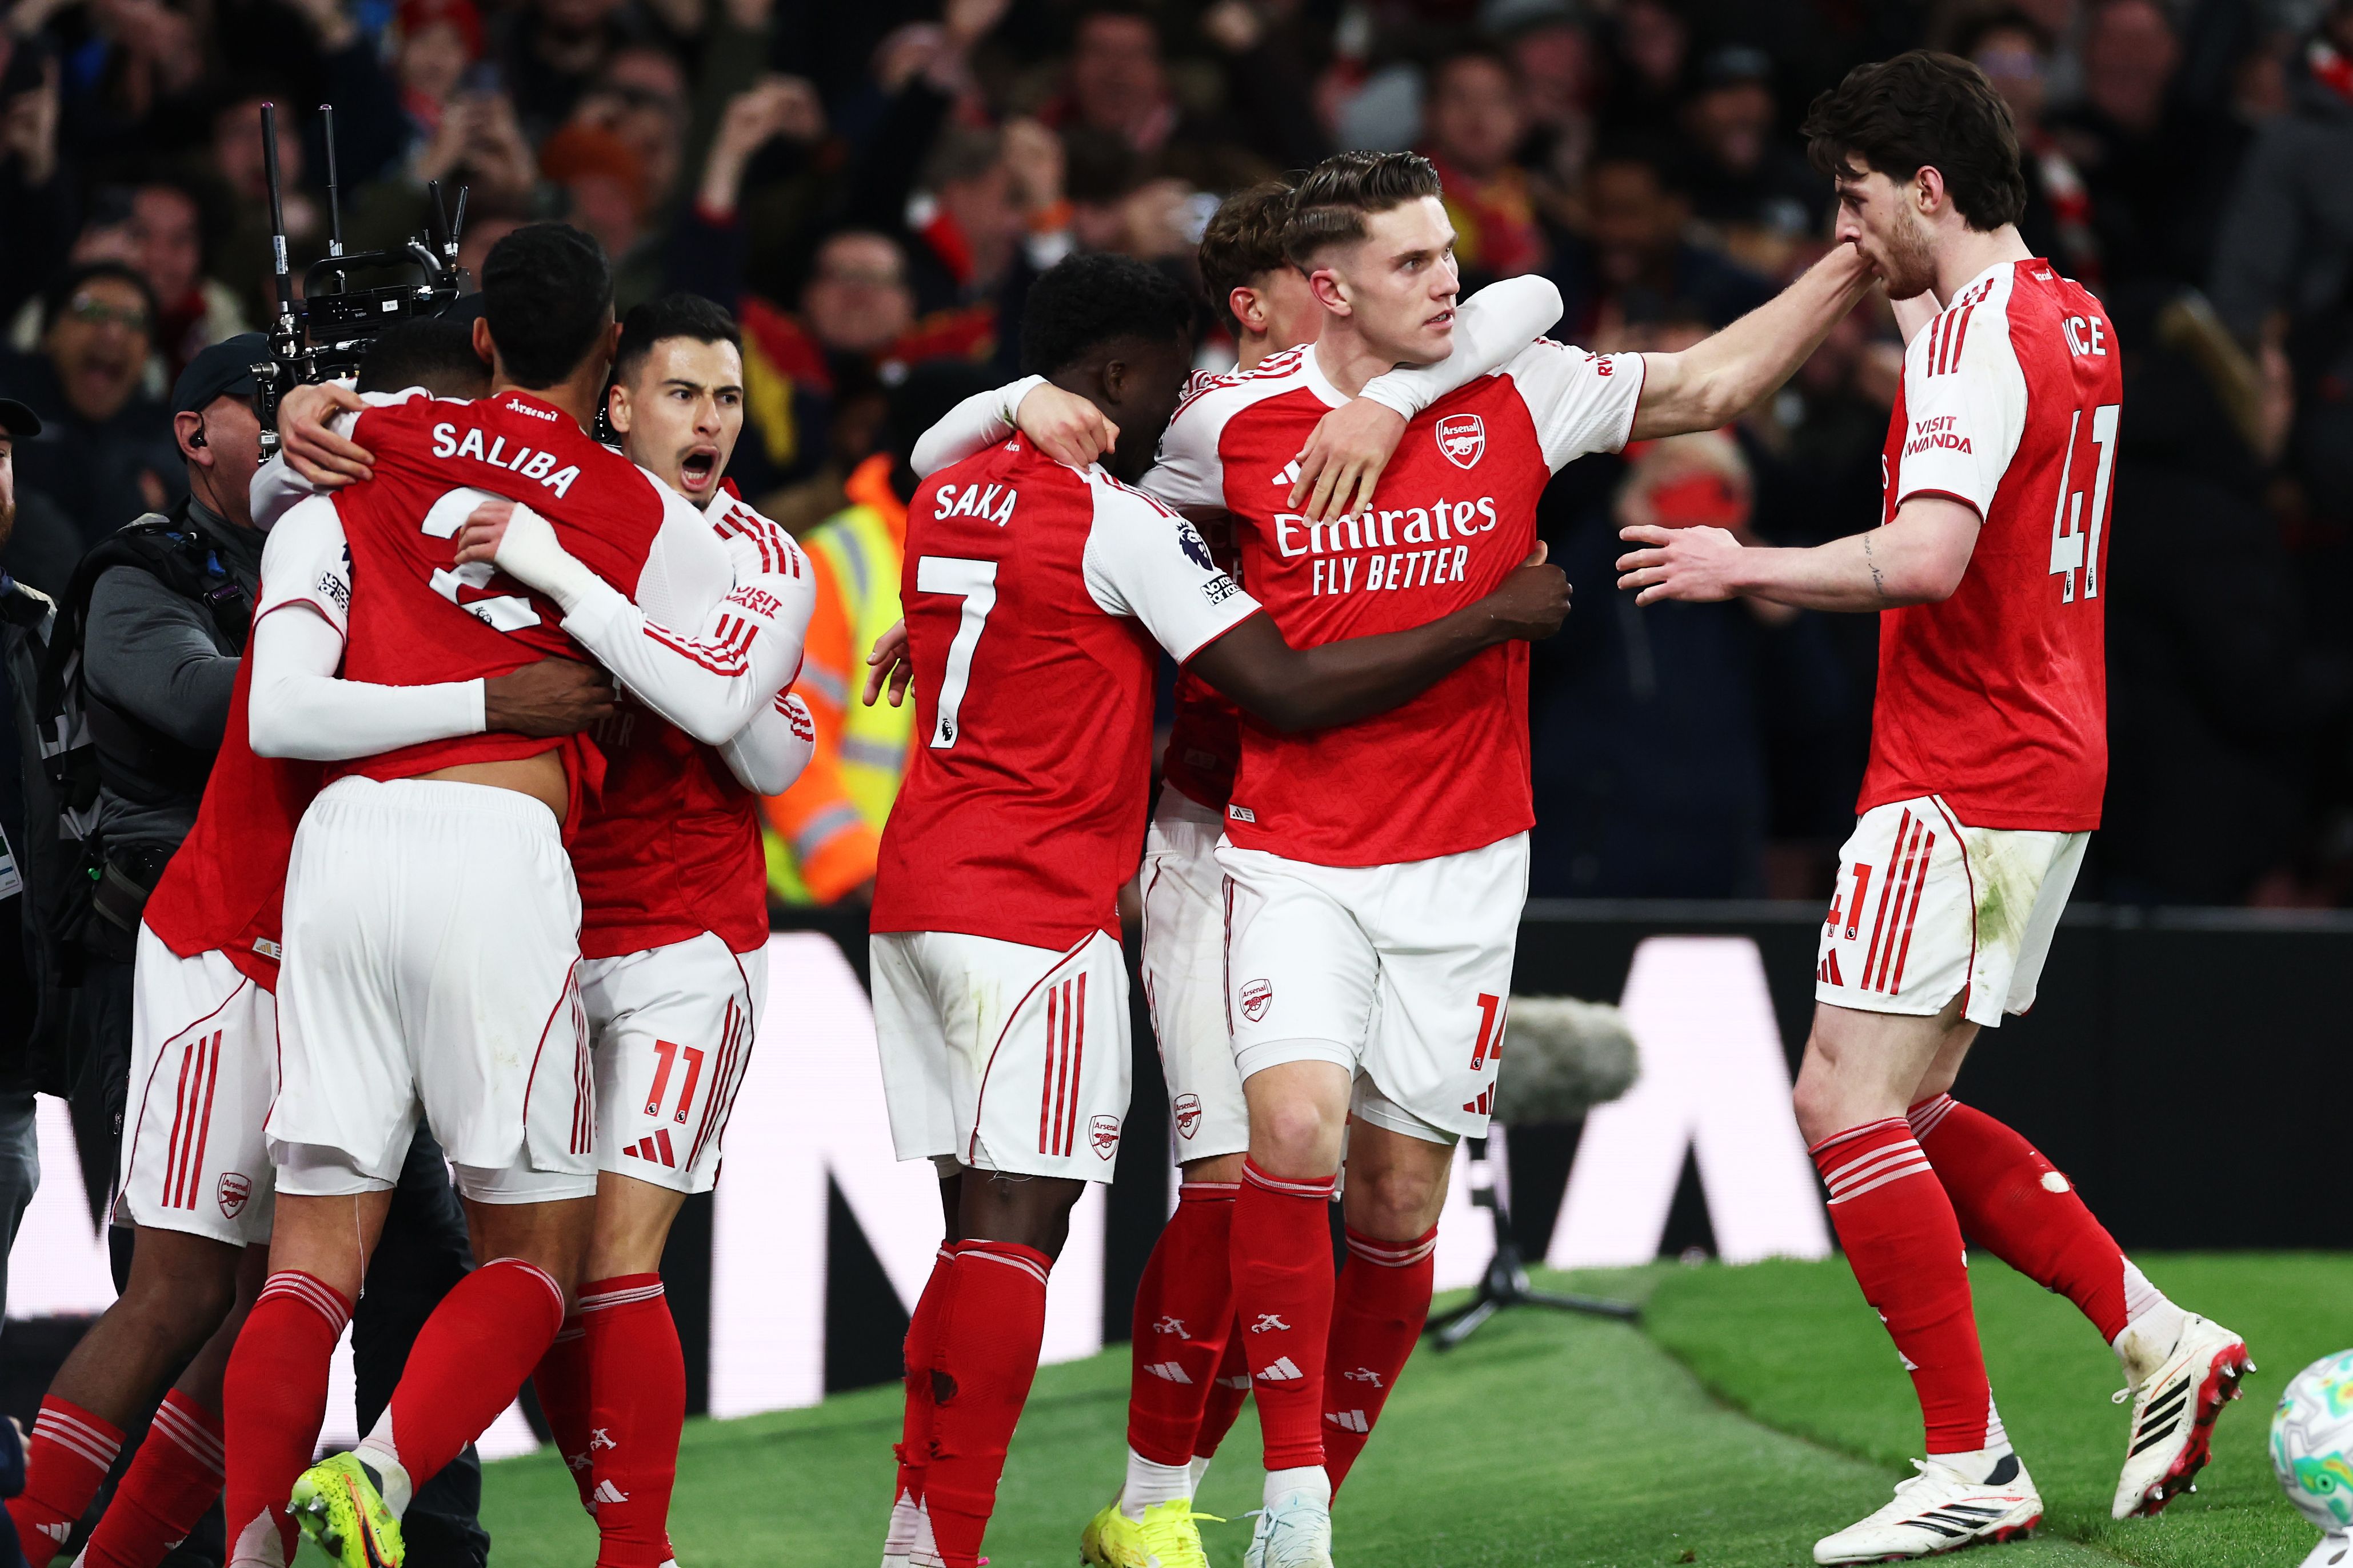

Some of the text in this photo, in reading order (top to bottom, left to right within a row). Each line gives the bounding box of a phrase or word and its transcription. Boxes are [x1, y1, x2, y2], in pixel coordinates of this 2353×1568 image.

[2062, 315, 2107, 357] ICE
[505, 398, 558, 422] Arsenal
[1443, 422, 1478, 435] Arsenal
[1915, 416, 1957, 436] VISIT
[432, 422, 581, 500] SALIBA
[1905, 433, 1972, 458] WANDA
[934, 483, 1017, 527] SAKA
[2050, 404, 2120, 604] 41
[1273, 495, 1497, 557] Emirates
[421, 486, 541, 633] 2
[1313, 545, 1468, 596] FLY BETTER
[1200, 582, 1220, 598] No
[916, 554, 998, 749] 7
[1243, 984, 1267, 998] Arsenal
[644, 1038, 705, 1125] 11
[1094, 1122, 1117, 1131] Arsenal
[223, 1179, 248, 1191] Arsenal
